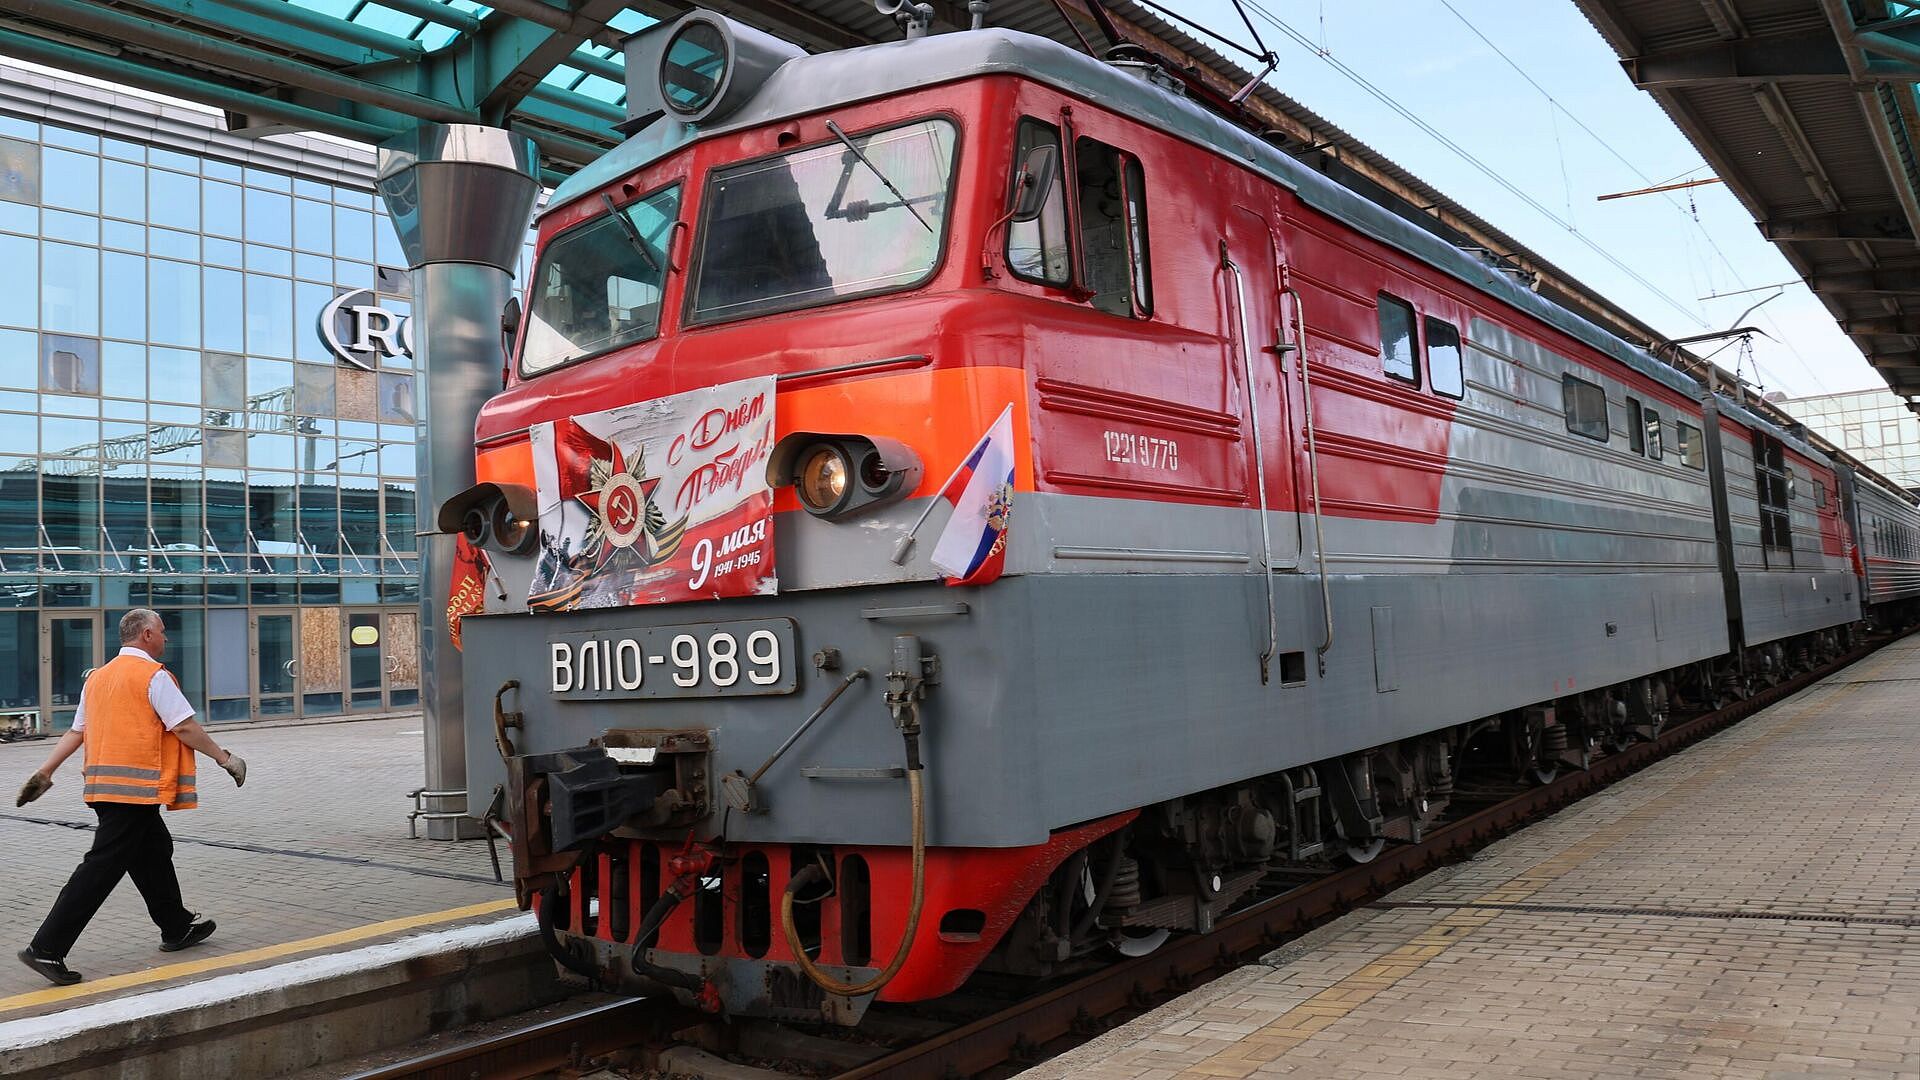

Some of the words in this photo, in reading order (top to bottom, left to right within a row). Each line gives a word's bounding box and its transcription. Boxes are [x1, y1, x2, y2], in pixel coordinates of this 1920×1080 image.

[674, 418, 772, 512] Победы!
[688, 538, 713, 590] 9
[716, 518, 766, 558] мая
[552, 630, 781, 692] ВЛ10-989
